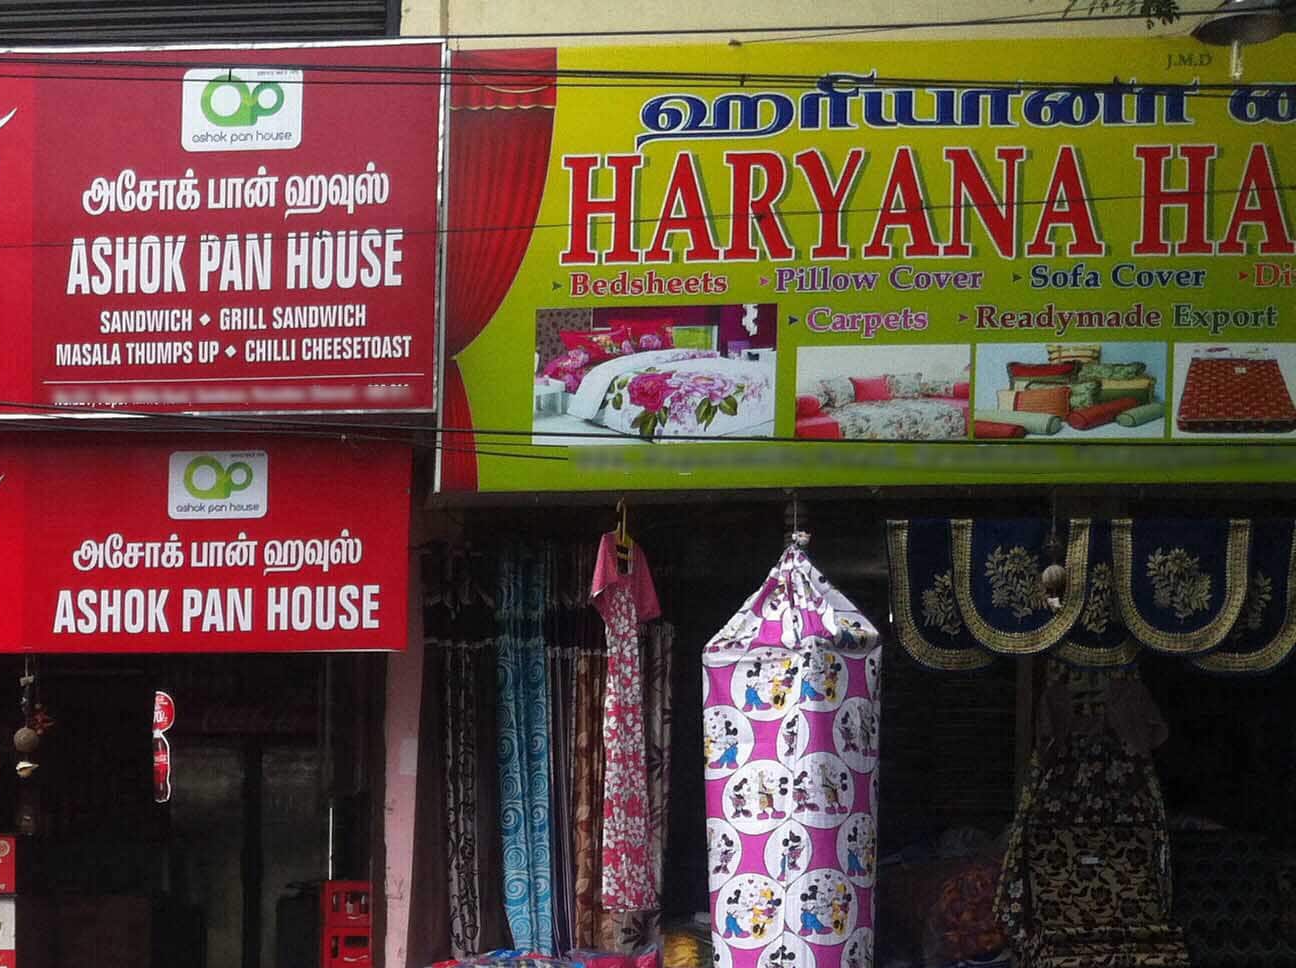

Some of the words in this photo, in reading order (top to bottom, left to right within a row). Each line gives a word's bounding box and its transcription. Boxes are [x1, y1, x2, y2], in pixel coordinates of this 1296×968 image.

[192, 130, 227, 144] ashok
[230, 132, 253, 145] pan
[255, 129, 292, 142] house
[82, 168, 200, 216] அசோக்
[208, 165, 278, 210] பான்
[284, 161, 390, 220] ஹவுஸ்
[559, 144, 1106, 265] HARYANA
[66, 235, 187, 295] ASHOK
[199, 233, 272, 292] PAN
[286, 229, 404, 290] HOUSE
[1030, 263, 1102, 289] Sofa
[1111, 263, 1207, 288] Cover
[570, 271, 728, 297] Bedsheets
[775, 267, 880, 292] Pillow
[889, 265, 984, 290] Cover
[100, 309, 192, 334] SANDWICH
[219, 308, 267, 331] GRILL
[272, 304, 366, 330] SANDWICH
[806, 307, 929, 338] Carpets
[975, 303, 1161, 336] Readymade
[1171, 303, 1280, 336] Export
[55, 343, 121, 366] MASALA
[126, 342, 193, 365] THUMPS
[198, 341, 219, 363] UP
[244, 339, 296, 362] CHILLI
[302, 335, 412, 361] CHEESETOAST
[176, 502, 206, 513] ashok
[208, 503, 227, 514] pan
[229, 502, 260, 512] house
[72, 533, 184, 571] அசோக்
[190, 531, 258, 568] பான்
[263, 528, 362, 576] ஹவுஸ்
[52, 588, 170, 634] ASHOK
[181, 587, 253, 633] PAN
[266, 584, 380, 631] HOUSE
